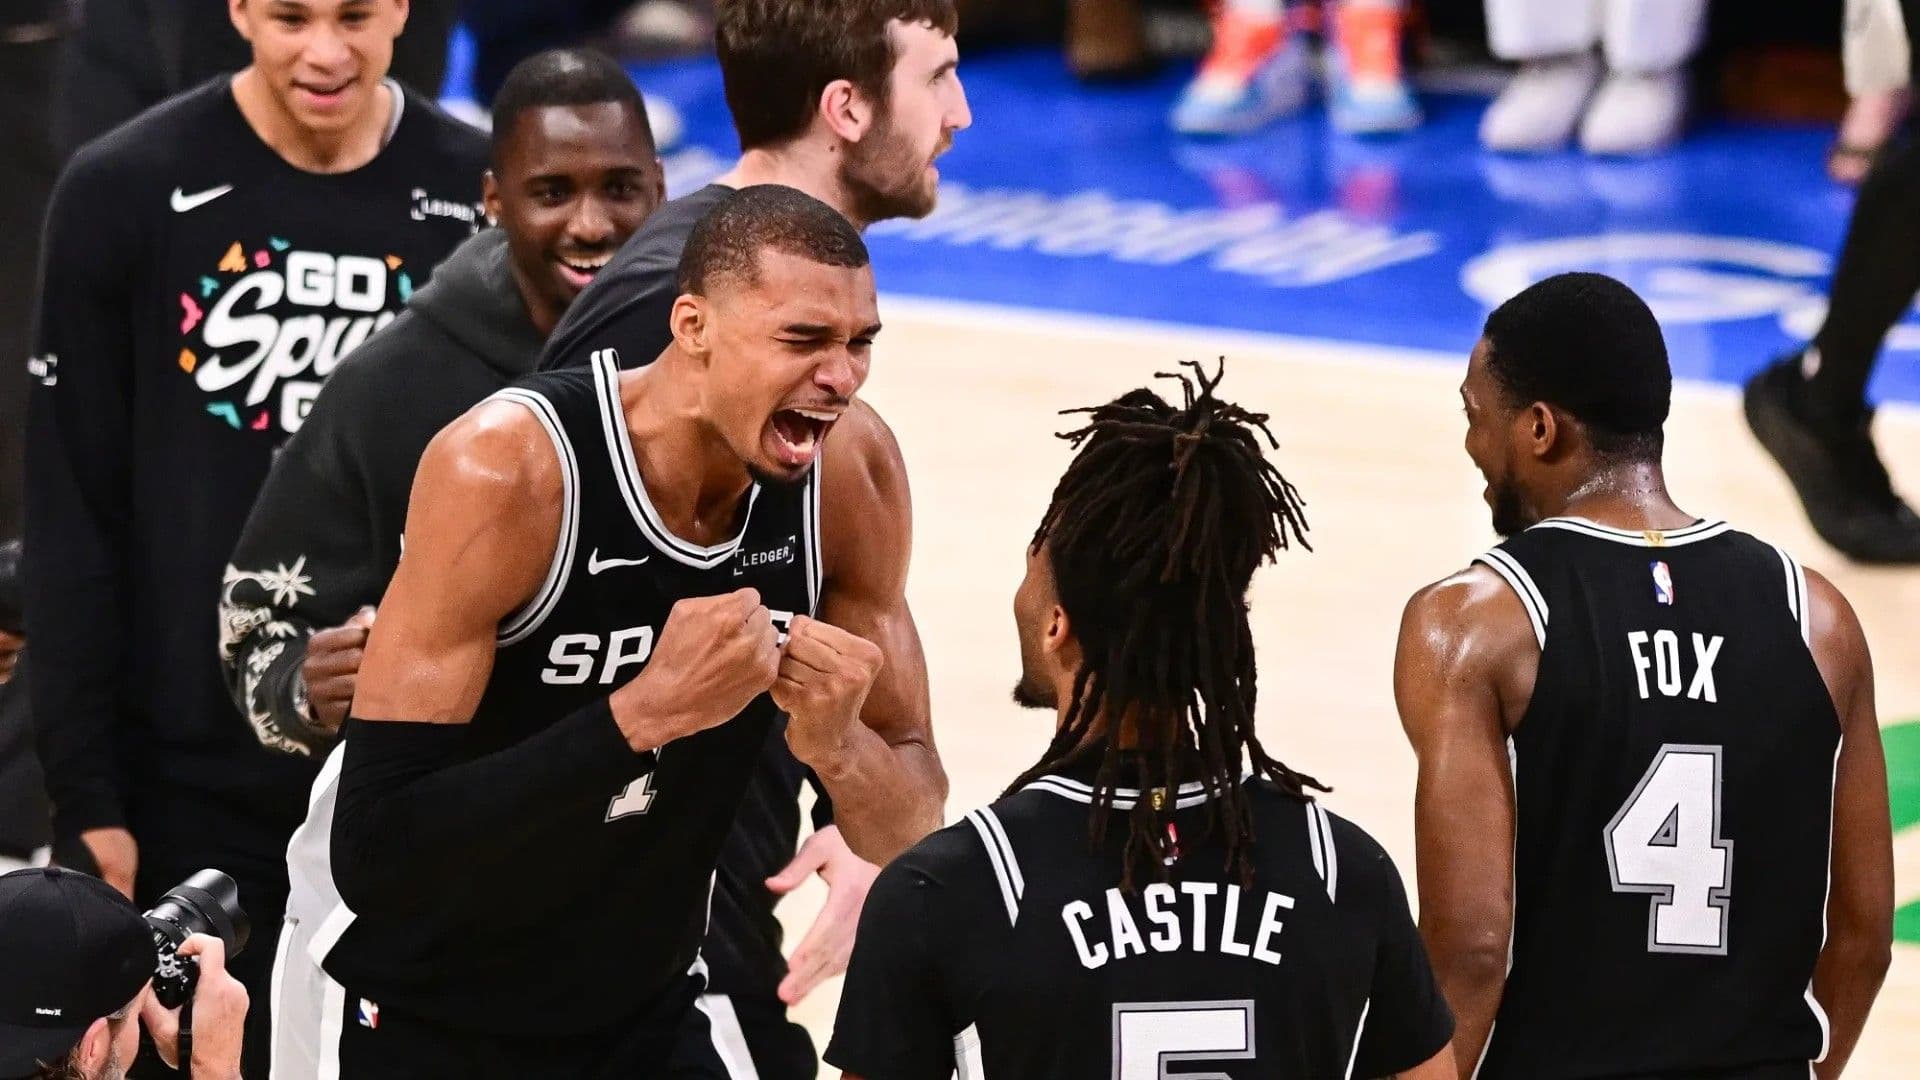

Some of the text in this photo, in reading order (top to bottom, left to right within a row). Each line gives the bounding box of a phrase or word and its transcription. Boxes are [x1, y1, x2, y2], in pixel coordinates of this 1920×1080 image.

[286, 250, 387, 312] GO
[195, 270, 396, 407] Spu
[742, 545, 790, 567] LEDGER
[1627, 629, 1725, 703] FOX
[1602, 743, 1734, 956] 4
[1061, 881, 1296, 970] CASTLE
